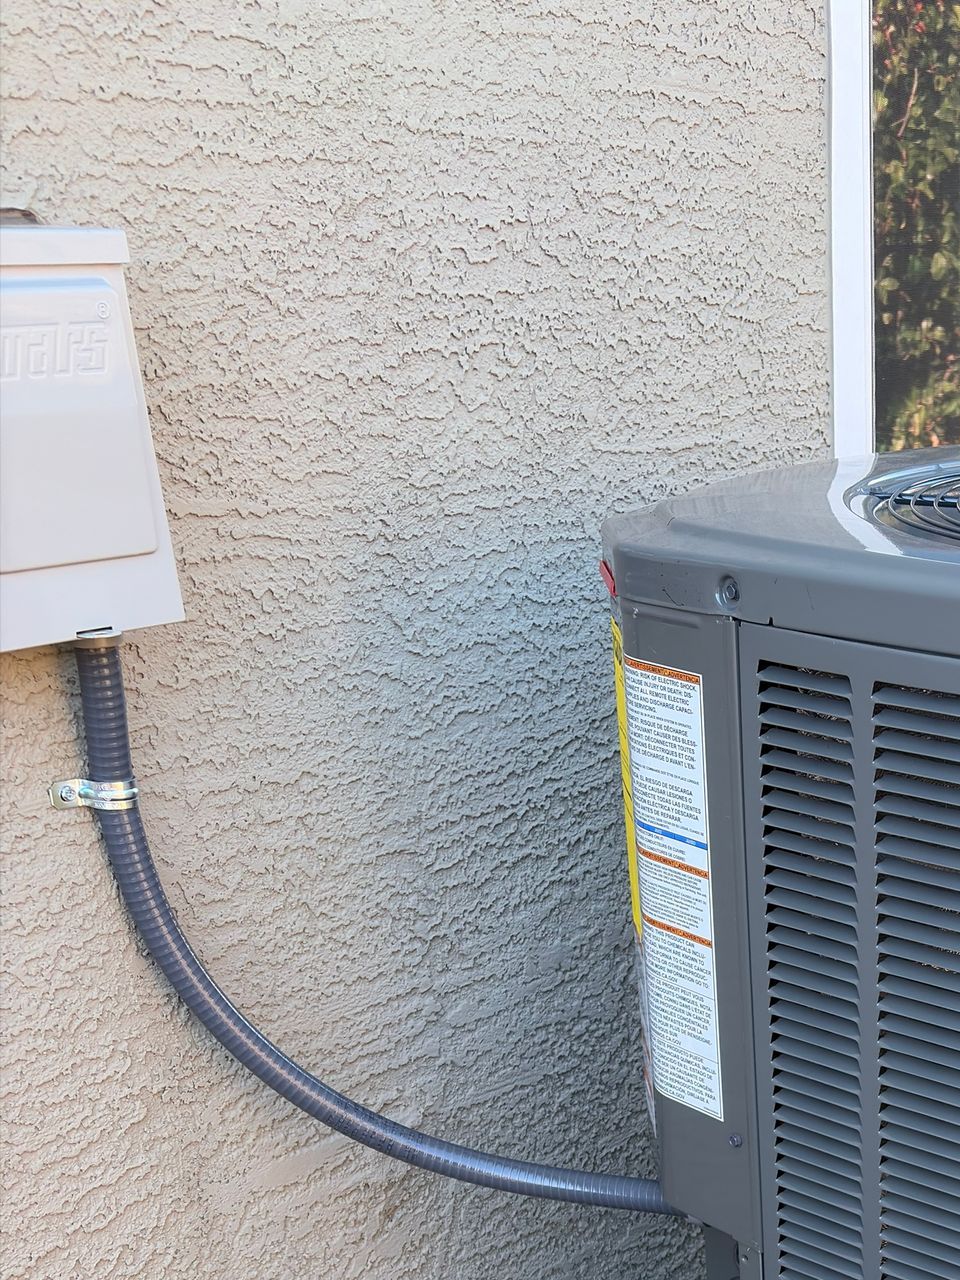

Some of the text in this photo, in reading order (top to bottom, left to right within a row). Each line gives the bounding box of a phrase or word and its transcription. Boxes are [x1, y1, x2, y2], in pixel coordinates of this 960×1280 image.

[644, 681, 659, 689] INJURY
[658, 677, 679, 687] ELECTRIC
[649, 691, 667, 700] REMOTE
[668, 696, 689, 705] ELECTRIC
[650, 699, 675, 710] DISCHARGE
[640, 719, 656, 728] RISQUE
[653, 730, 671, 740] CAUSER
[678, 745, 695, 754] TOUTES
[645, 777, 661, 786] RIESGO
[669, 784, 693, 796] DESCARGA
[648, 786, 666, 794] CAUSAR
[667, 792, 687, 802] LESIONES
[657, 796, 671, 804] TODAS
[682, 804, 701, 814] FUENTES
[675, 809, 699, 820] DESCARGA
[665, 933, 685, 944] PRODUCT
[686, 940, 695, 948] CAN
[667, 941, 691, 953] CHEMICALS
[658, 944, 672, 952] WHICH
[682, 953, 698, 963] KNOWN
[668, 962, 682, 971] OTHER
[679, 959, 694, 969] CAUSE
[694, 965, 711, 976] CANCER
[667, 969, 694, 983] INFORMATION
